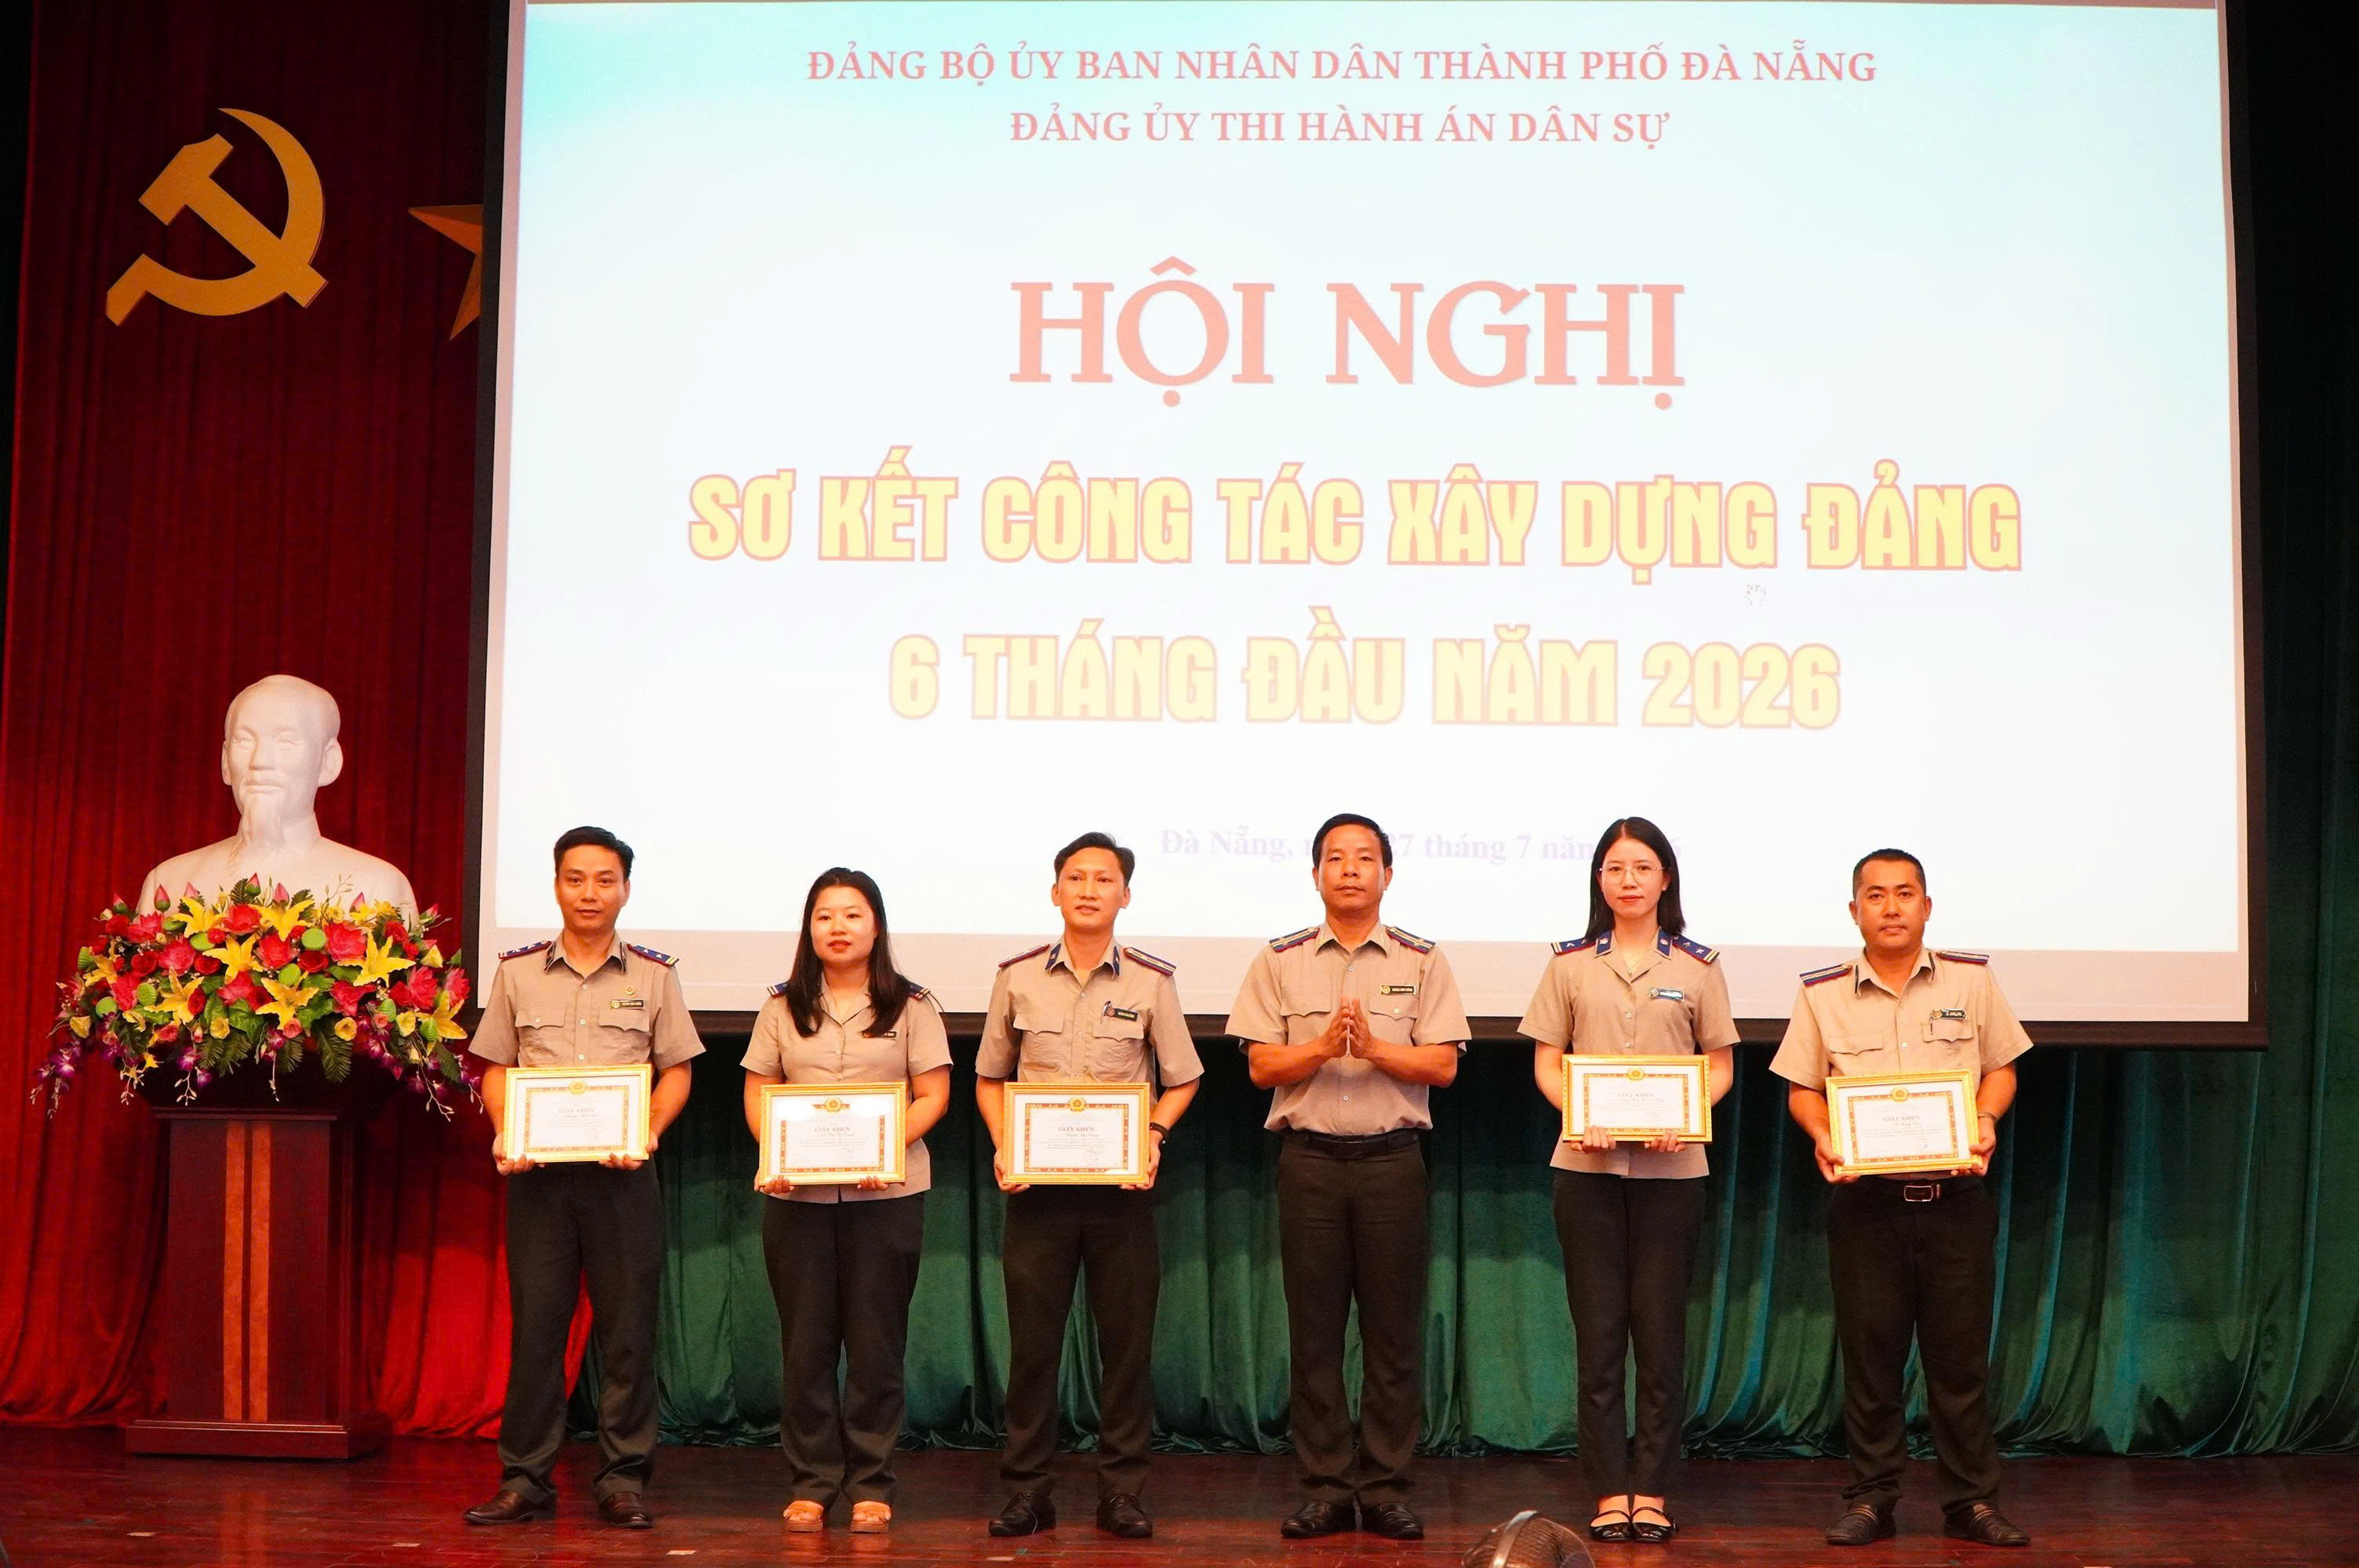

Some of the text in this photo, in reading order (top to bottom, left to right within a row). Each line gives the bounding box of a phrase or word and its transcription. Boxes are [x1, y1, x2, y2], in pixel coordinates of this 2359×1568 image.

[807, 38, 1877, 86] ĐẢNG BỘ ỦY BAN NHÂN DÂN THÀNH PHỐ ĐÀ NẴNG
[1009, 102, 1671, 151] ĐẢNG ỦY THI HÀNH ÁN DÂN SỰ
[1009, 256, 1685, 411] HỘI NGHỊ
[688, 445, 2023, 586] SƠ KẾT CÔNG TÁC XÂY DỰNG ĐẢNG
[889, 605, 1841, 731] 6 THÁNG ĐẦU NĂM 2026
[1160, 829, 1199, 855] Đà
[1207, 823, 1294, 862] Nẵng,
[1424, 832, 1506, 865] tháng
[1515, 833, 1532, 859] 7
